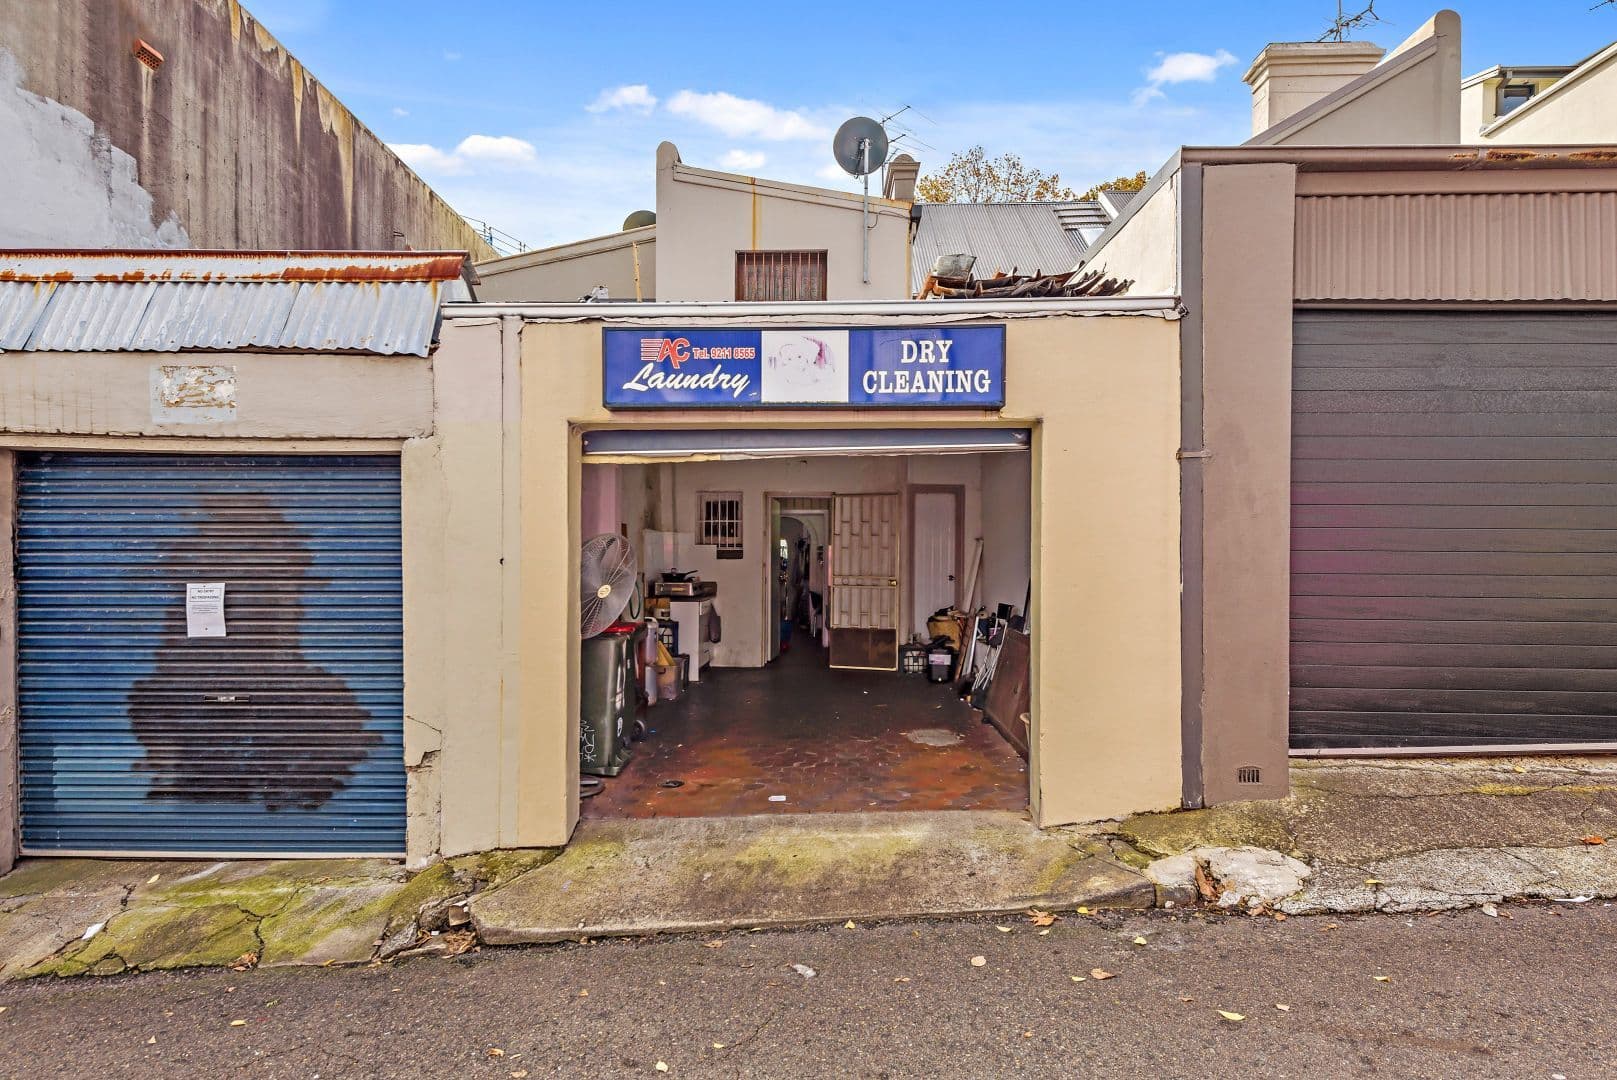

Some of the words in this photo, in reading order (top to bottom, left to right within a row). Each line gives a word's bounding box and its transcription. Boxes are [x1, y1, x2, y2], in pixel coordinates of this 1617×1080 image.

[656, 337, 691, 369] AC
[692, 347, 710, 360] Tel.
[711, 347, 732, 360] 9211
[733, 347, 756, 360] 8565
[900, 340, 953, 364] DRY
[622, 362, 751, 398] Laundry
[862, 369, 992, 395] CLEANING
